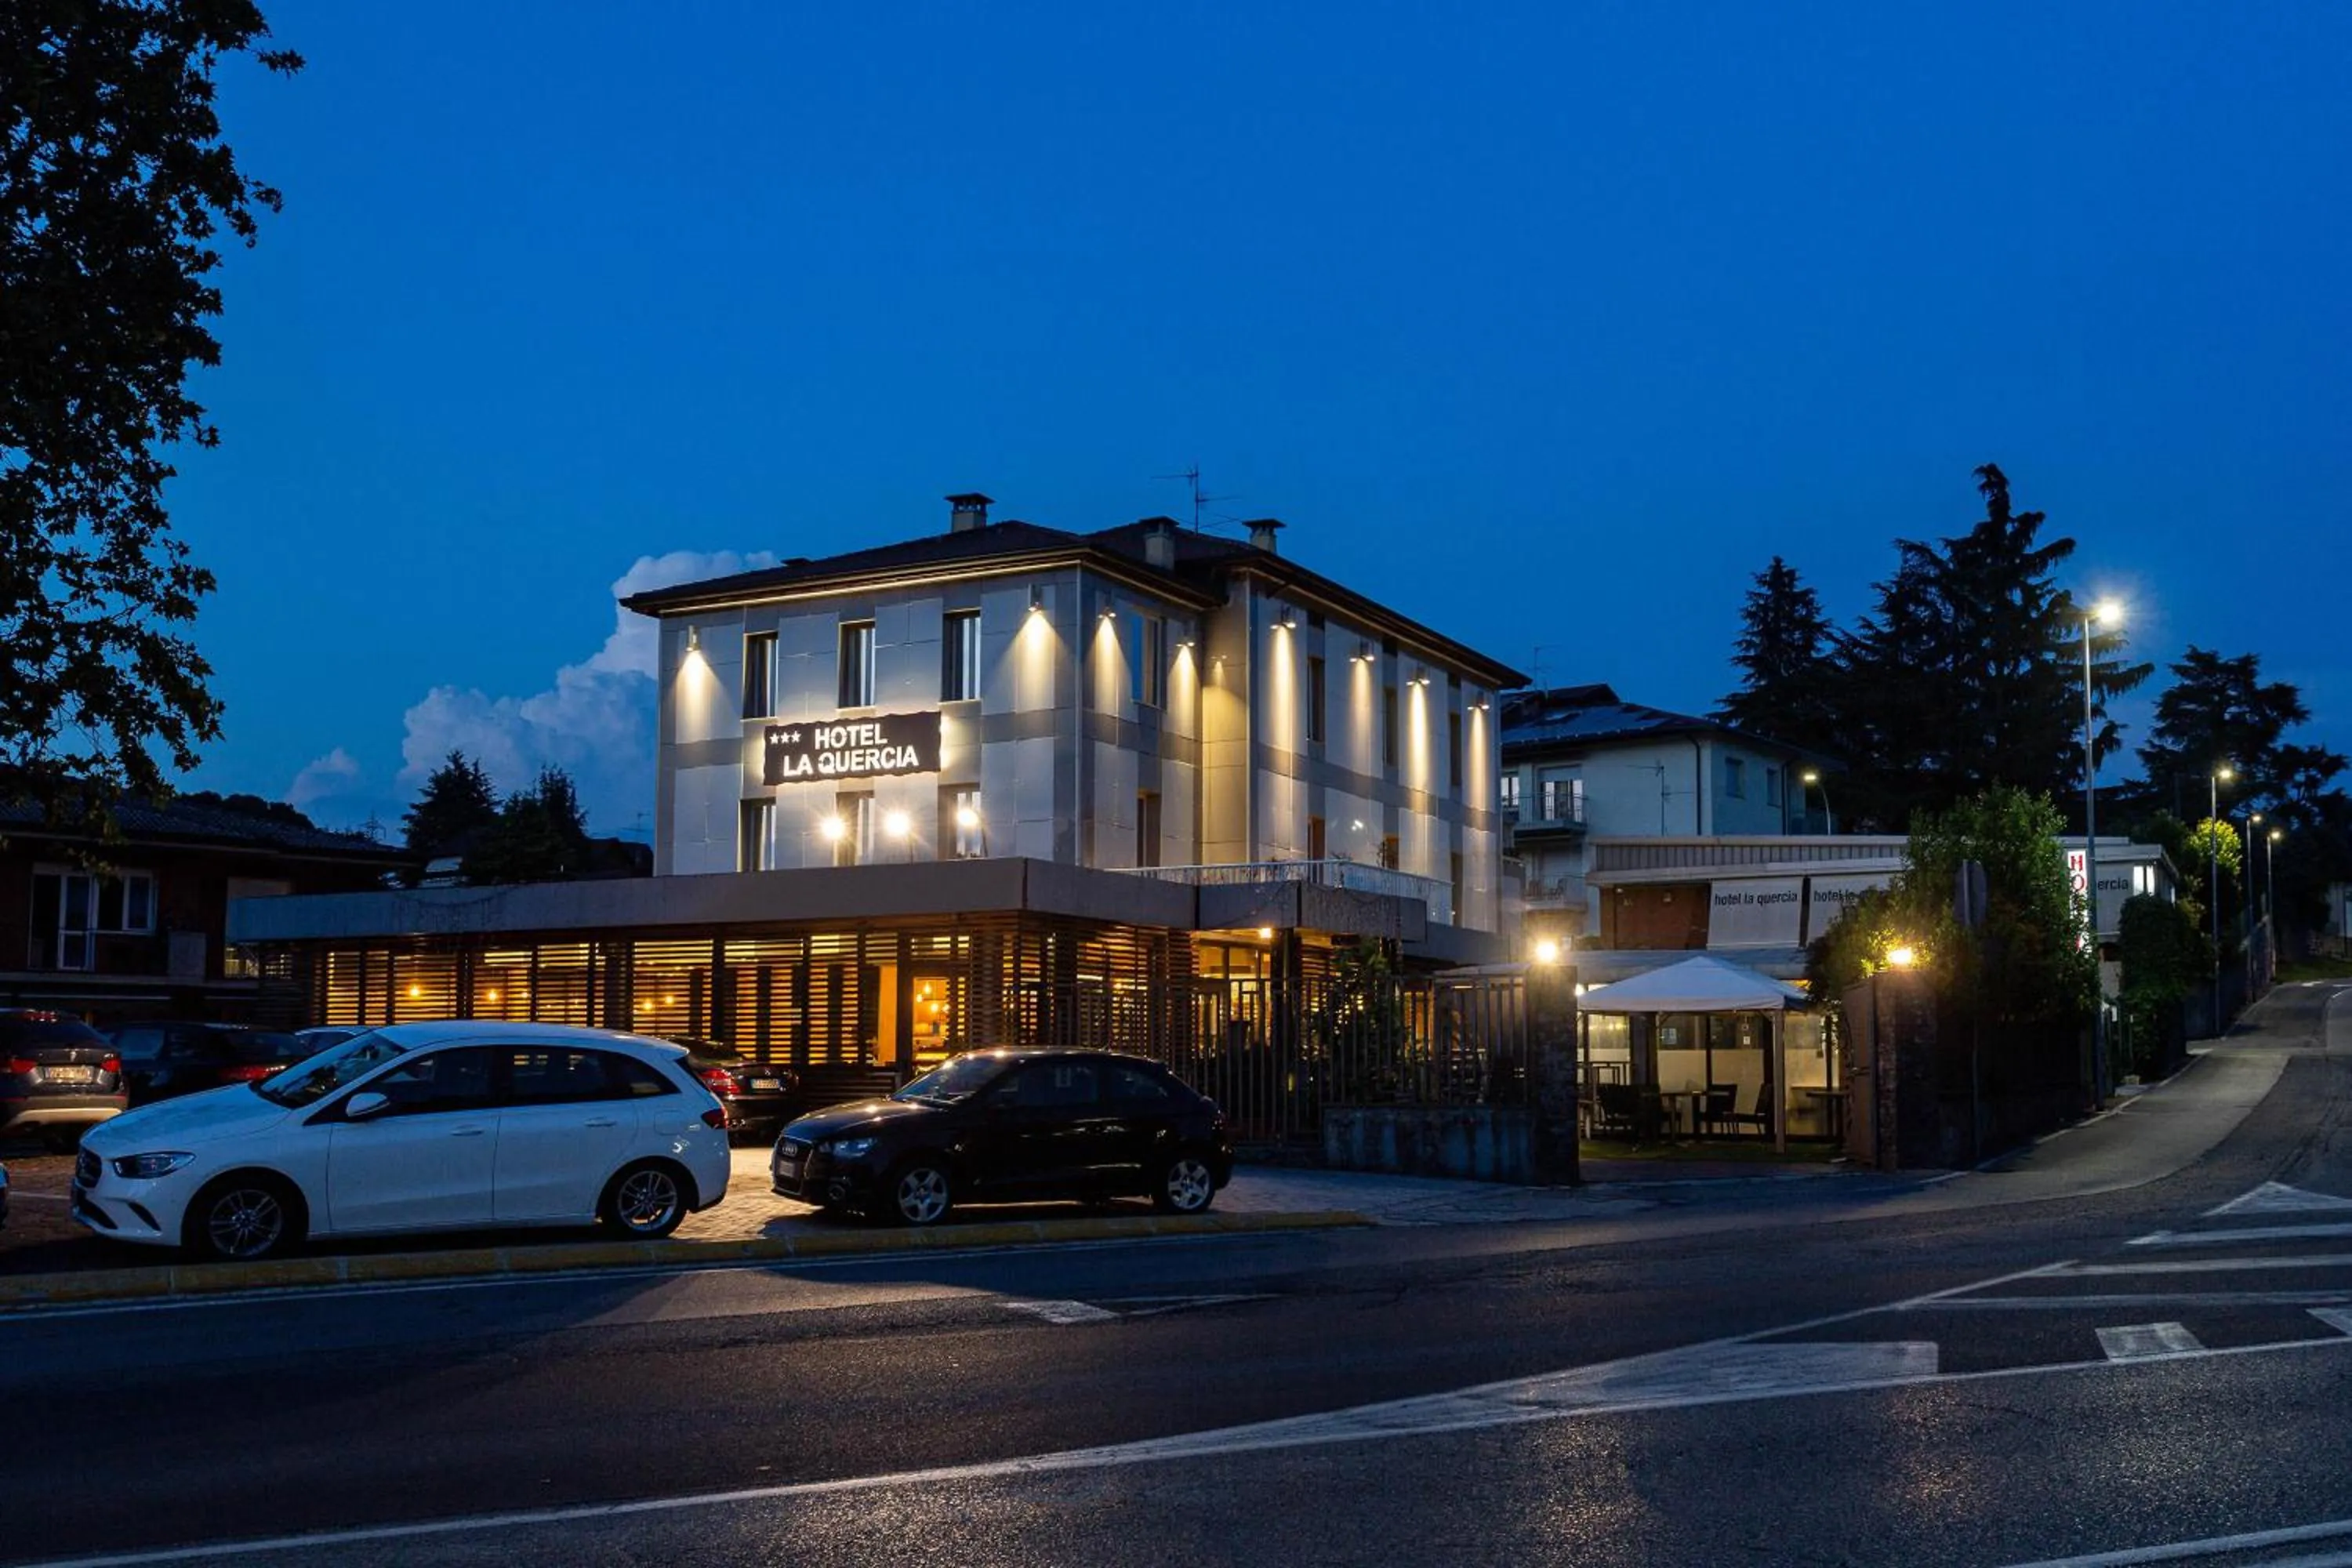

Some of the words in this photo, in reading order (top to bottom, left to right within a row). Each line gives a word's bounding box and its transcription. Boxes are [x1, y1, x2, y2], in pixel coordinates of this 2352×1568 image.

[815, 723, 888, 750] HOTEL
[783, 753, 814, 776] LA
[818, 745, 919, 775] QUERCIA
[2097, 877, 2129, 891] ercia
[1715, 892, 1741, 906] hotel
[1744, 892, 1754, 904] la
[1757, 891, 1798, 906] quercia
[1813, 890, 1842, 902] hotel
